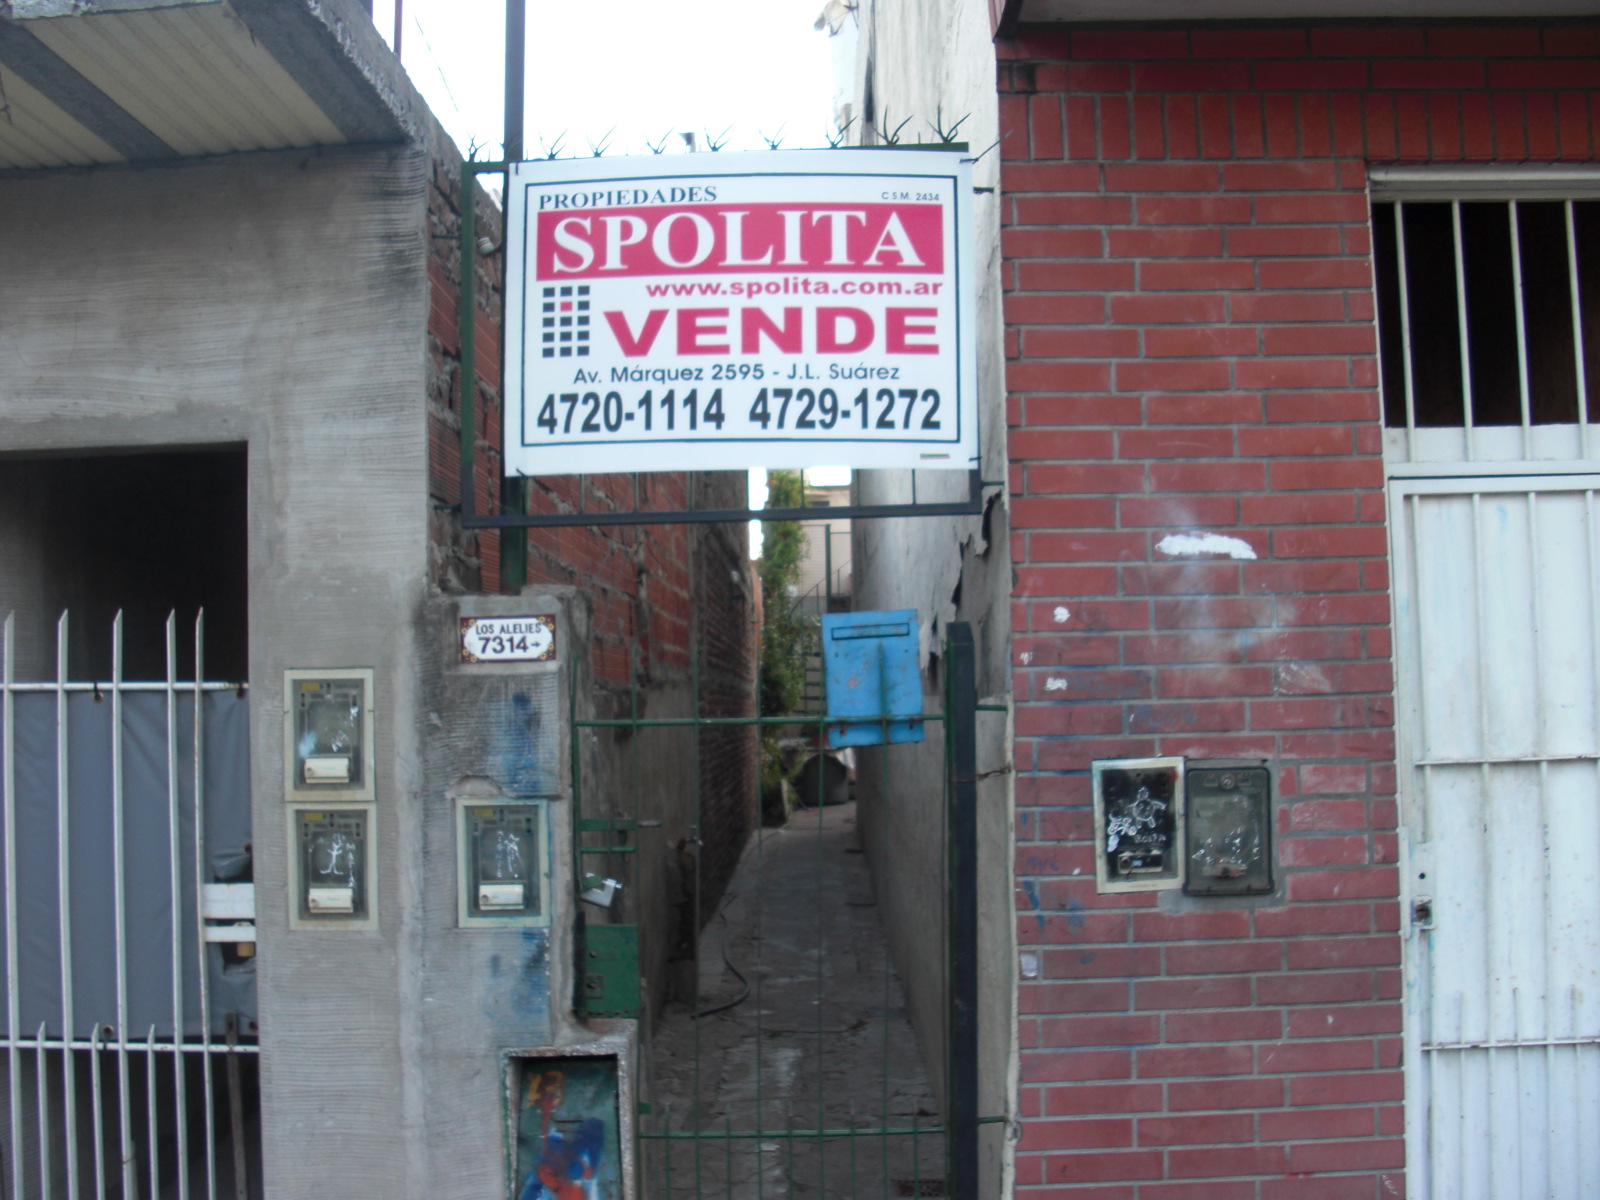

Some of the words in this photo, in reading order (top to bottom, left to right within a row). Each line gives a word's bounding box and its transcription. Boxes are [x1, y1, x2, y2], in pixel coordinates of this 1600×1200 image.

[538, 186, 718, 210] PROPIEDADES
[915, 193, 940, 201] 2434
[553, 210, 925, 273] SPOLITA
[646, 277, 943, 299] www.spolita.com.ar
[603, 306, 940, 358] VENDE
[573, 368, 602, 384] Av.
[610, 365, 704, 385] Márquez
[711, 363, 765, 381] 2595
[828, 363, 900, 380] Suárez
[537, 388, 725, 434] 4720-1114
[749, 388, 941, 430] 4729-1272
[476, 624, 494, 635] LOS
[500, 623, 541, 635] ALELIES
[478, 636, 529, 654] 7314
